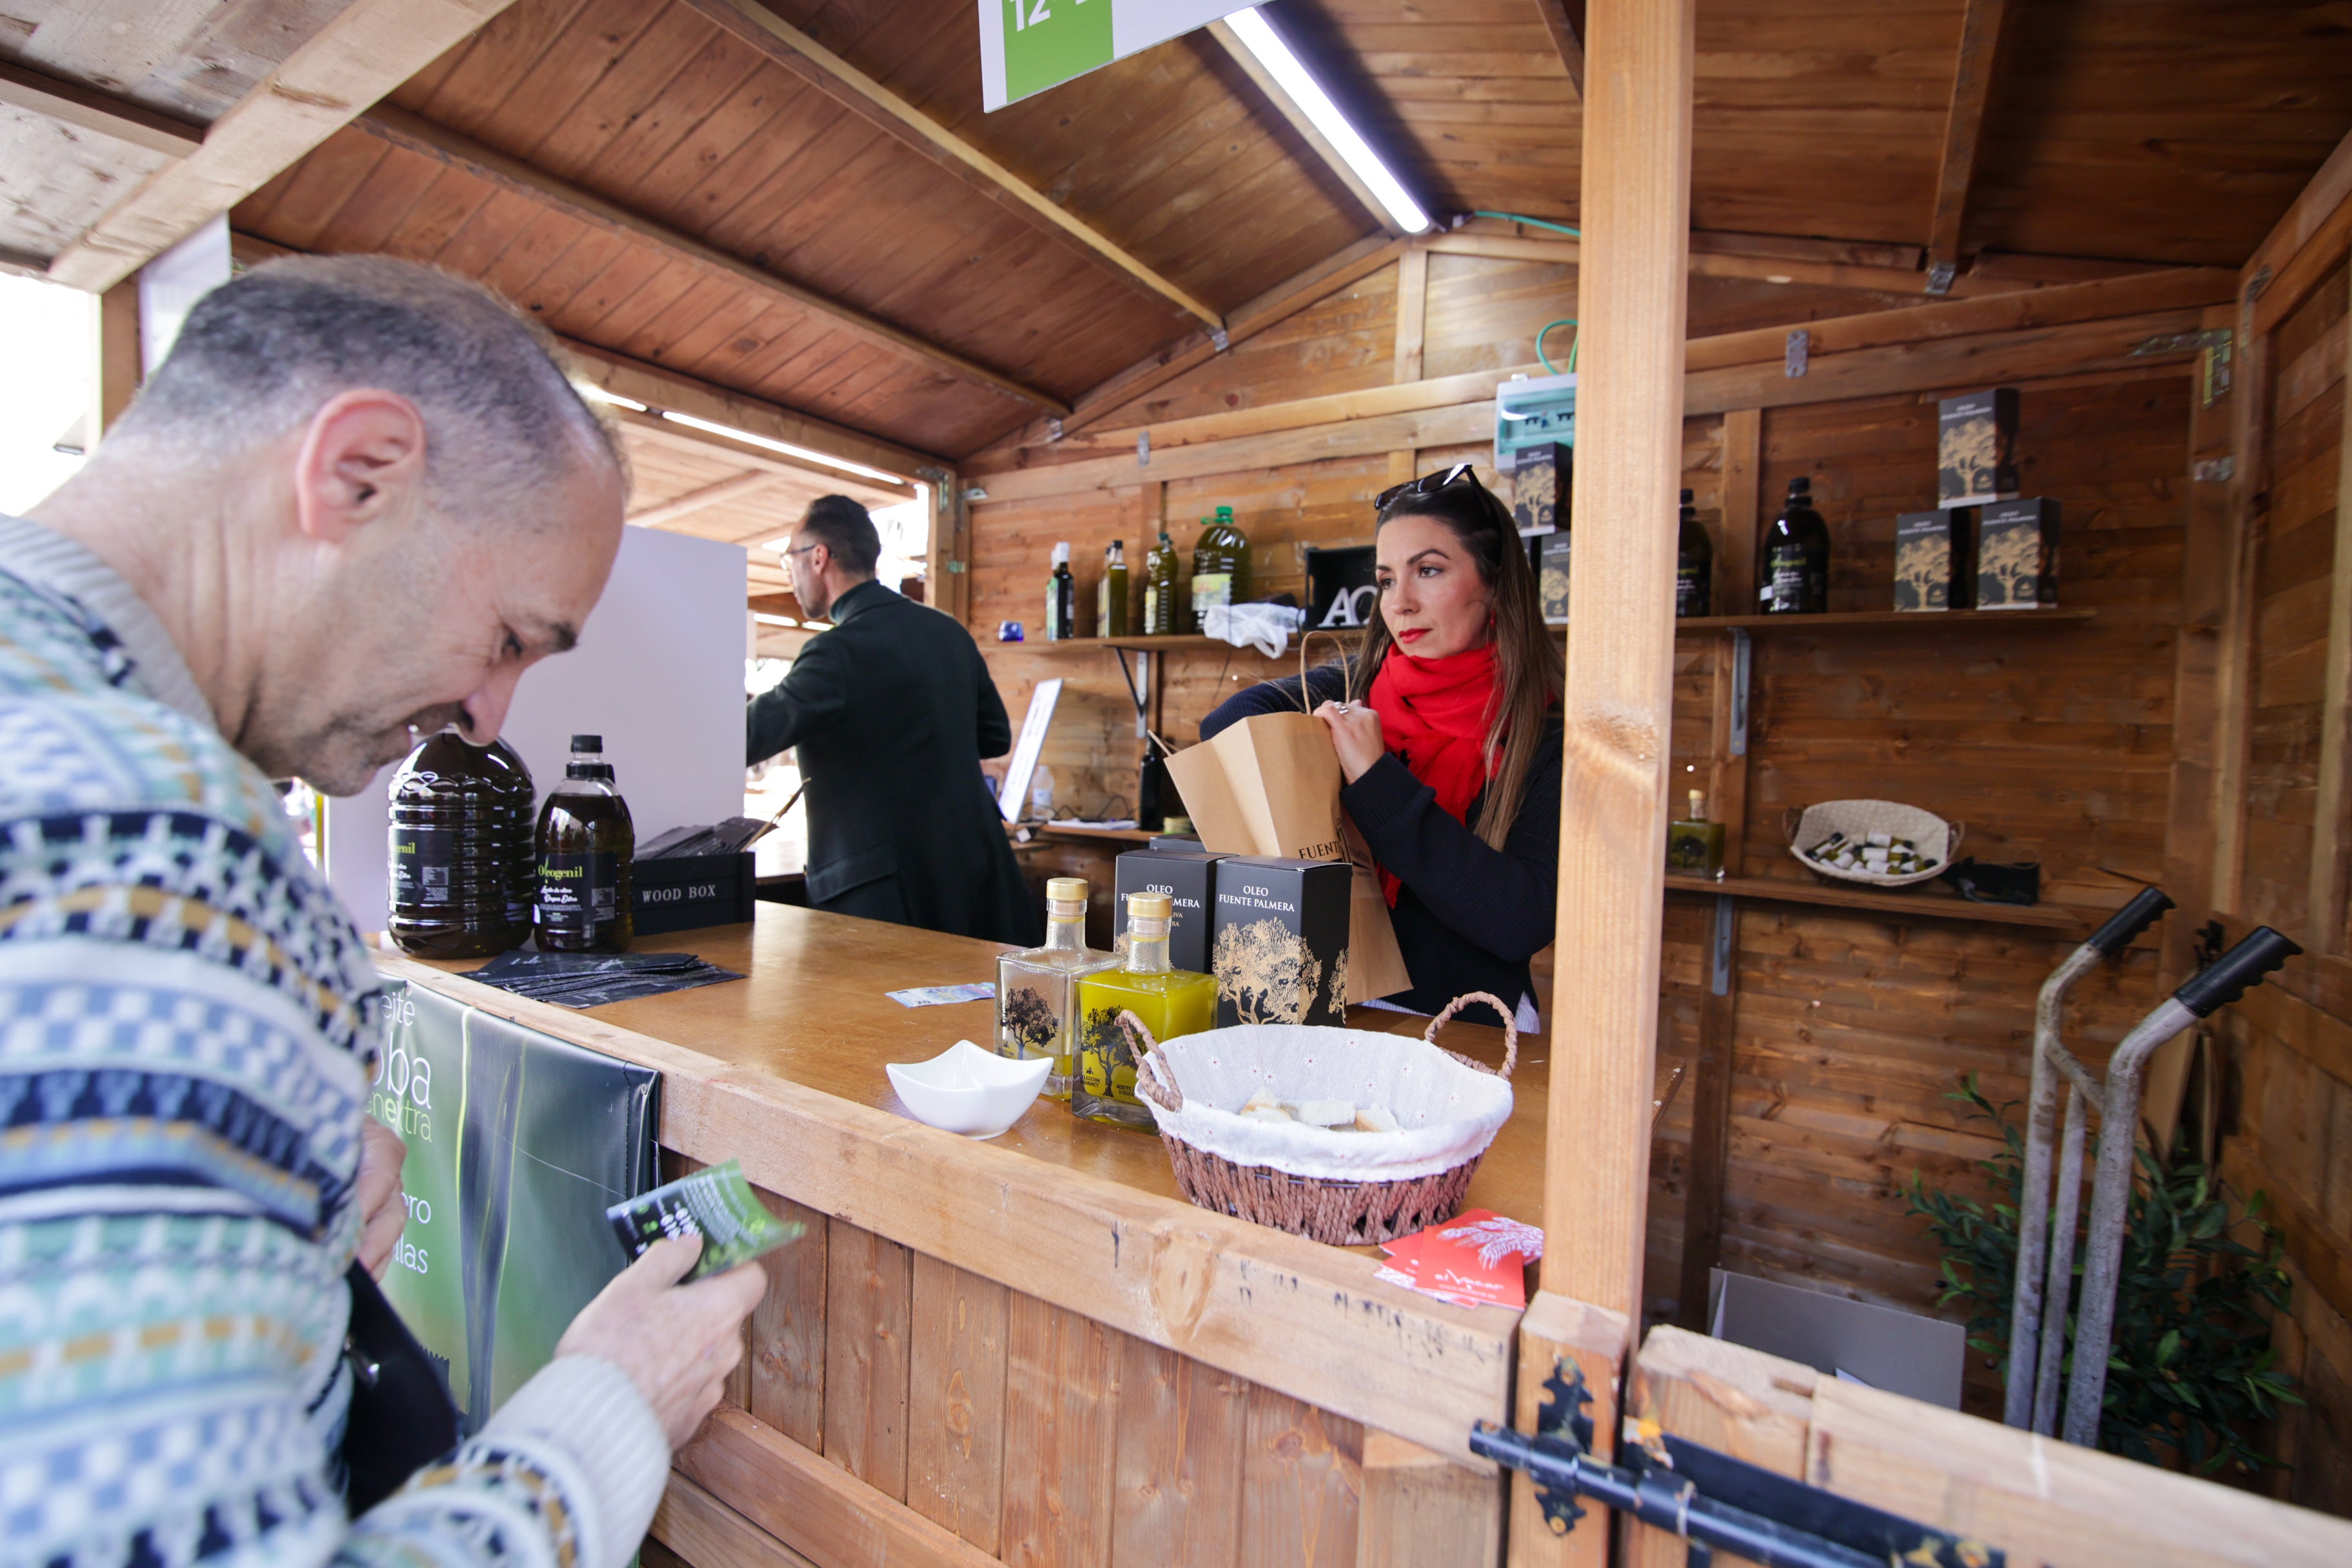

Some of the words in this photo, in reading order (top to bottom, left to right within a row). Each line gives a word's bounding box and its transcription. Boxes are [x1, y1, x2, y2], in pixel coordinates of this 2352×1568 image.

[643, 888, 681, 903] WOOD
[689, 885, 716, 899] BOX
[1146, 884, 1173, 894] OLEO
[1243, 885, 1269, 896] OLEO
[1219, 894, 1251, 906] FUENTE
[1254, 899, 1295, 912] PALMERA
